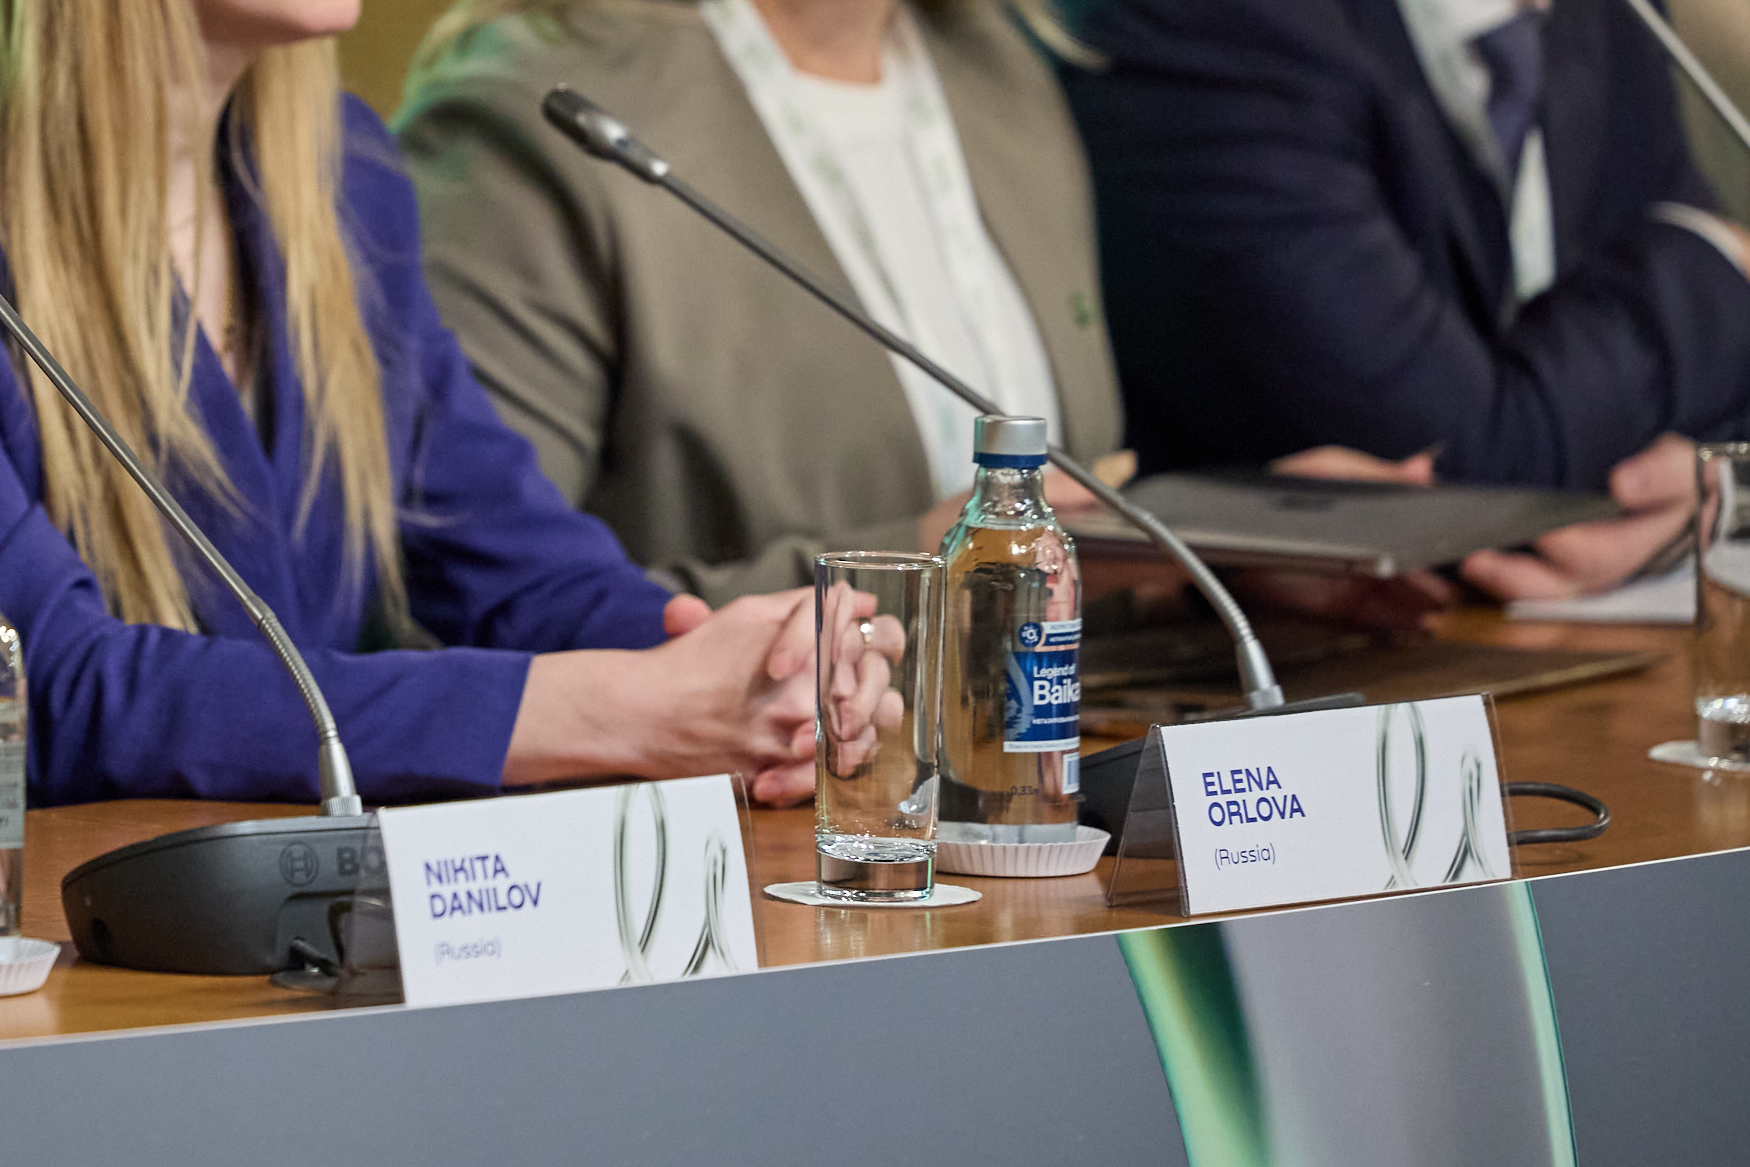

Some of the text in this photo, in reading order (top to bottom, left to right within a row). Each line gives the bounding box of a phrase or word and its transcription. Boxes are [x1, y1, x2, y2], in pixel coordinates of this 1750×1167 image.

[1033, 665, 1068, 679] Legend
[1033, 678, 1081, 706] Baika
[1202, 766, 1282, 796] ELENA
[1208, 794, 1306, 827] ORLOVA
[423, 854, 510, 888] NIKITA
[1214, 842, 1276, 871] (Russia)
[428, 882, 542, 920] DANILOV
[433, 935, 502, 965] (Russia)
